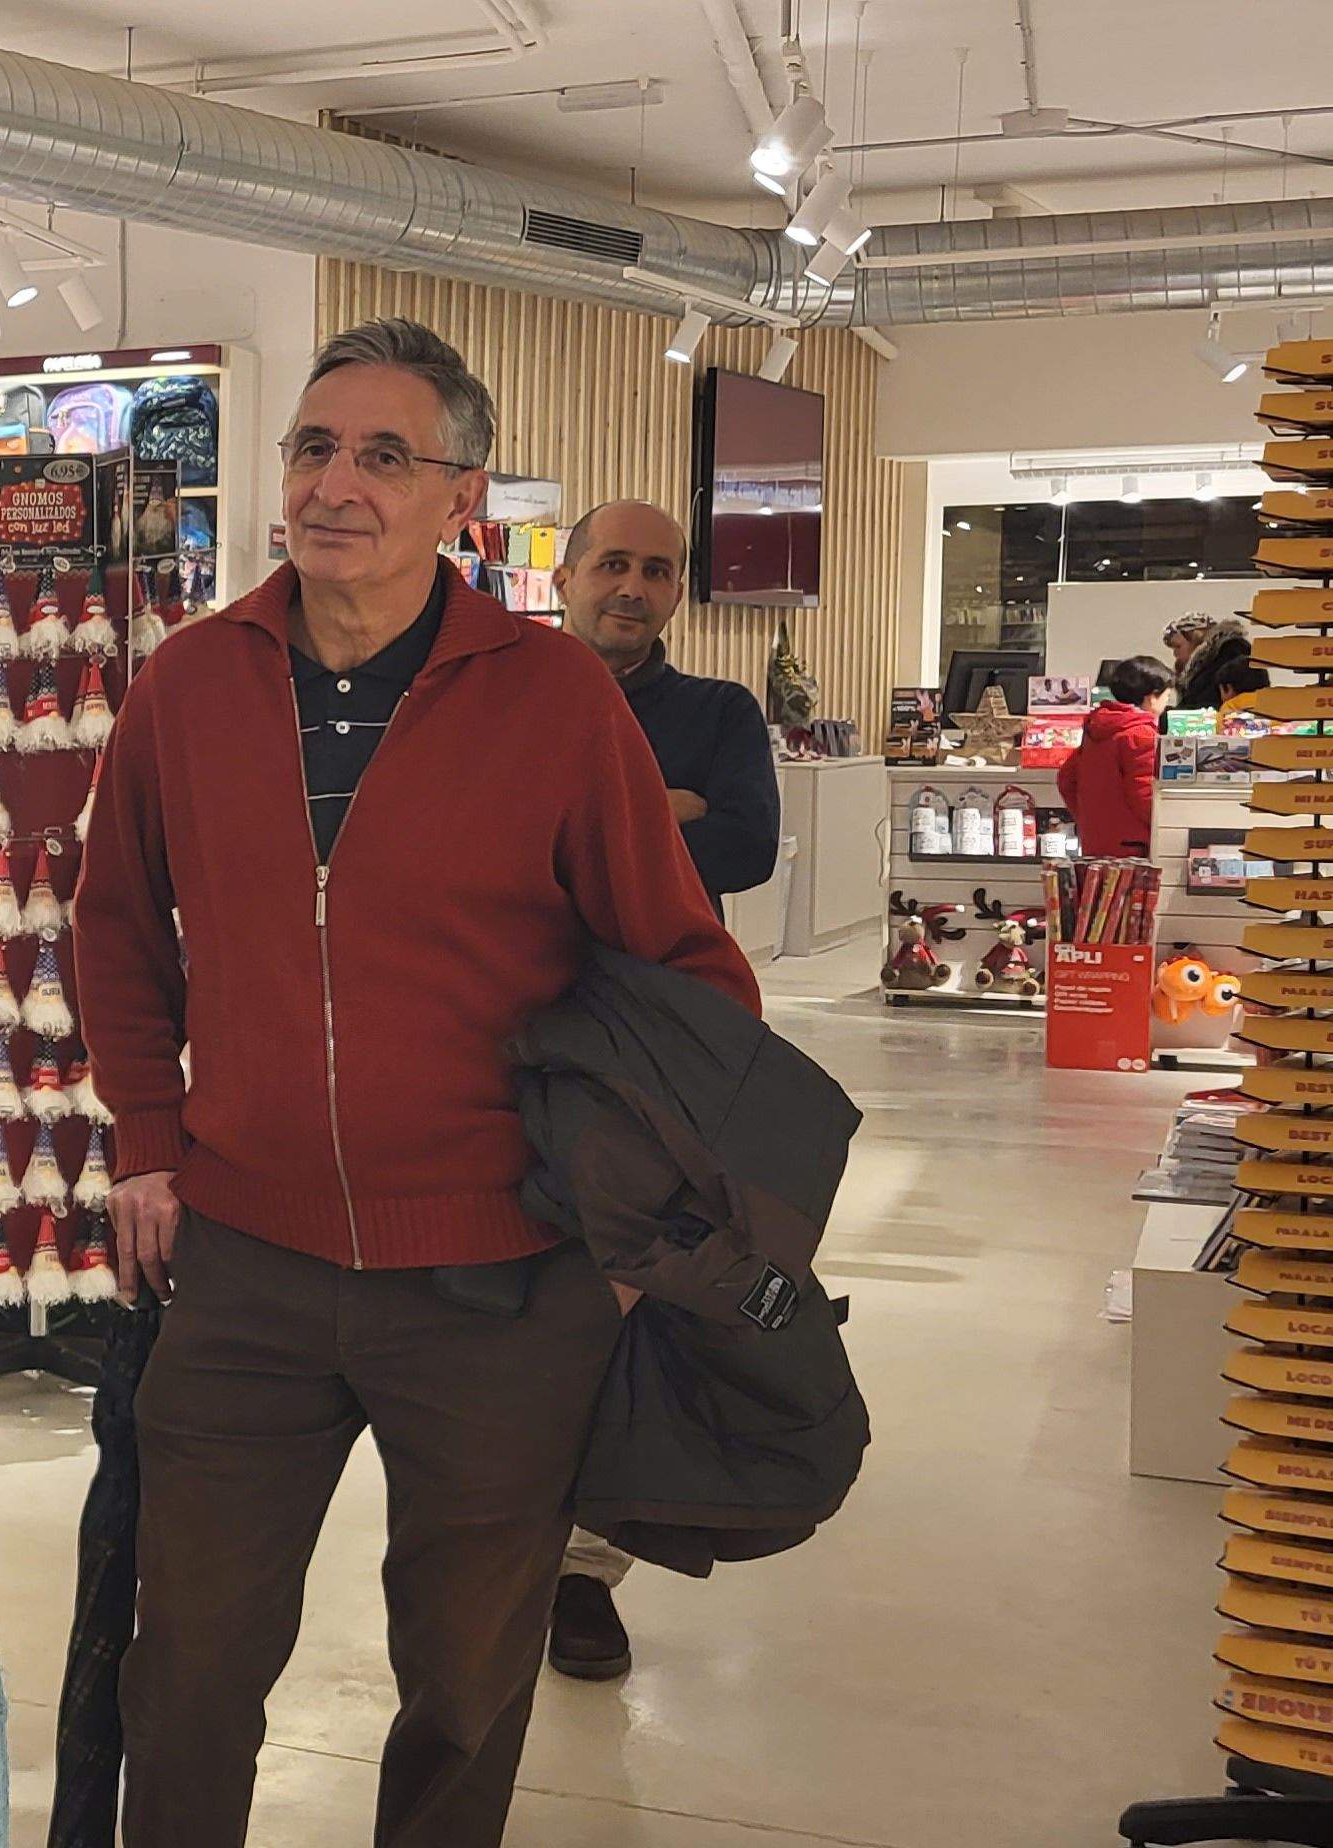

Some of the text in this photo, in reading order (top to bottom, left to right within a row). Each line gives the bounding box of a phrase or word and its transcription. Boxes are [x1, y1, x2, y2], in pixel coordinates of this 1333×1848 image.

[12, 491, 64, 506] GNOMOS
[0, 506, 77, 521] PERSONALIZADOS
[7, 521, 28, 533] con
[51, 520, 70, 534] led
[1055, 950, 1102, 965] APLI
[1288, 1130, 1332, 1142] BEST
[1286, 1371, 1332, 1385] LOCO
